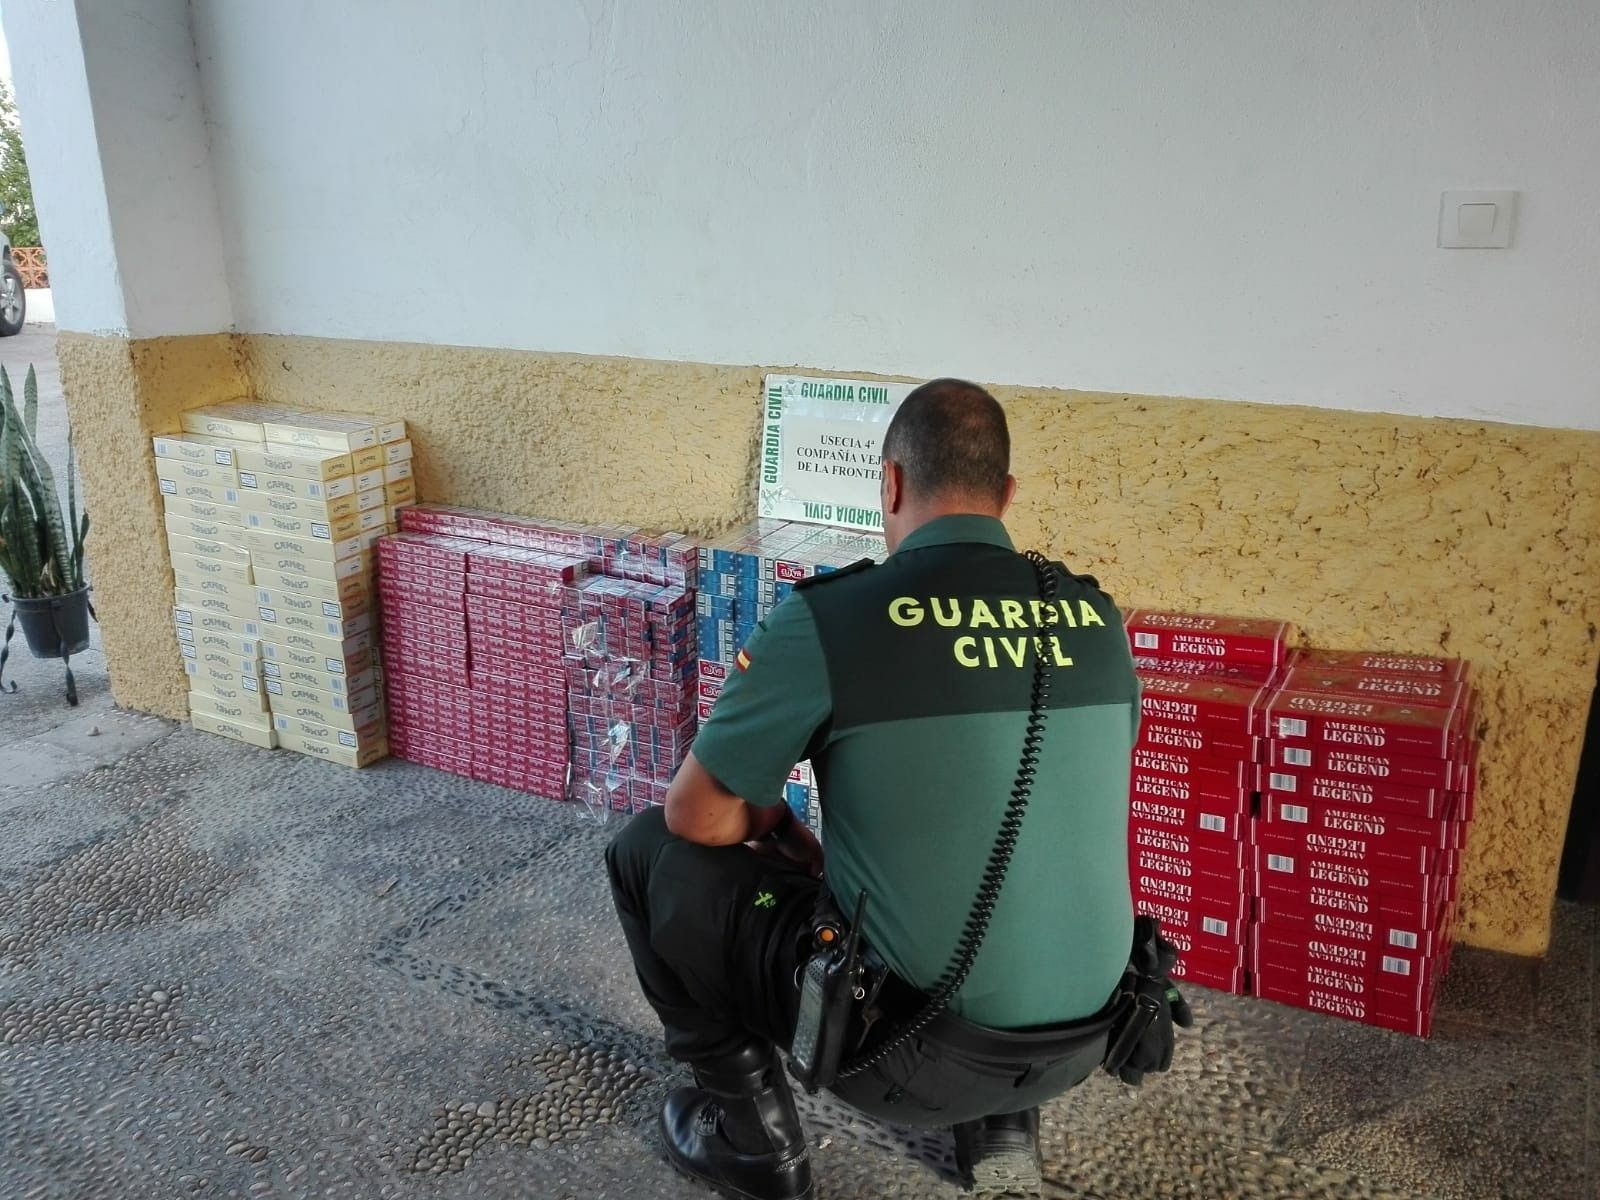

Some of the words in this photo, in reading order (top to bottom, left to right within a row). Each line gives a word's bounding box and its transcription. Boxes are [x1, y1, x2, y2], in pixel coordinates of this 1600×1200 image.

[801, 382, 854, 402] GUARDIA
[859, 386, 890, 404] CIVIL
[768, 386, 782, 419] CIVIL
[821, 435, 861, 449] USECIA
[764, 424, 780, 484] GUARDIA
[861, 454, 882, 465] VEJ
[798, 461, 812, 471] DE
[815, 464, 829, 474] LA
[832, 465, 882, 480] FRONTE
[803, 502, 832, 522] CIVIL
[836, 506, 883, 528] UARDIA
[888, 596, 1106, 629] GUARDIA
[1173, 634, 1225, 645] AMERICAN
[1172, 642, 1225, 656] LEGEND
[1362, 661, 1443, 673] LEGEND
[1142, 678, 1190, 689] LEGE
[1357, 682, 1441, 696] LEGEND
[1143, 698, 1198, 711] LEGEND
[1290, 697, 1373, 713] LEGEND
[1142, 710, 1198, 723] AMERICAN
[1149, 724, 1202, 738] AMERICAN
[1324, 721, 1386, 734] AMERICAN
[1148, 732, 1202, 750] LEGEND
[1323, 729, 1385, 747] LEGEND
[1136, 750, 1189, 763] AMERICAN
[1328, 751, 1390, 765] AMERICAN
[1135, 757, 1189, 774] LEGEND
[1328, 759, 1390, 777] LEGEND
[1136, 774, 1190, 789] AMERICAN
[1313, 778, 1373, 792] AMERICAN
[1136, 782, 1190, 800] LEGEND
[1313, 785, 1373, 804] LEGEND
[1132, 801, 1185, 817] LEGEND
[1324, 809, 1386, 824] AMERICAN
[1132, 811, 1185, 826] AMERICAN
[1324, 816, 1385, 836] LEGEND
[1137, 827, 1190, 843] AMERICAN
[1137, 834, 1189, 853] LEGEND
[1306, 833, 1366, 853] LEGEND
[1140, 851, 1192, 866] AMERICAN
[1307, 845, 1366, 860] AMERICAN
[1140, 857, 1192, 877] LEGEND
[1310, 860, 1369, 876] AMERICAN
[1140, 876, 1192, 896] LEGEND
[1309, 868, 1369, 887] LEGEND
[1141, 887, 1192, 903] AMERICAN
[1310, 886, 1369, 902] AMERICAN
[1138, 900, 1189, 921] LEGEND
[1310, 894, 1369, 914] LEGEND
[1315, 914, 1373, 934] LEGEND
[1315, 924, 1373, 941] AMERICAN
[1161, 929, 1192, 941] RICAN
[1308, 941, 1367, 961] LEGEND
[1308, 952, 1365, 968] AMERICAN
[1307, 965, 1364, 984] AMERICAN
[1307, 972, 1364, 993] LEGEND
[1308, 990, 1365, 1008] AMERICAN
[1308, 997, 1365, 1018] LEGEND
